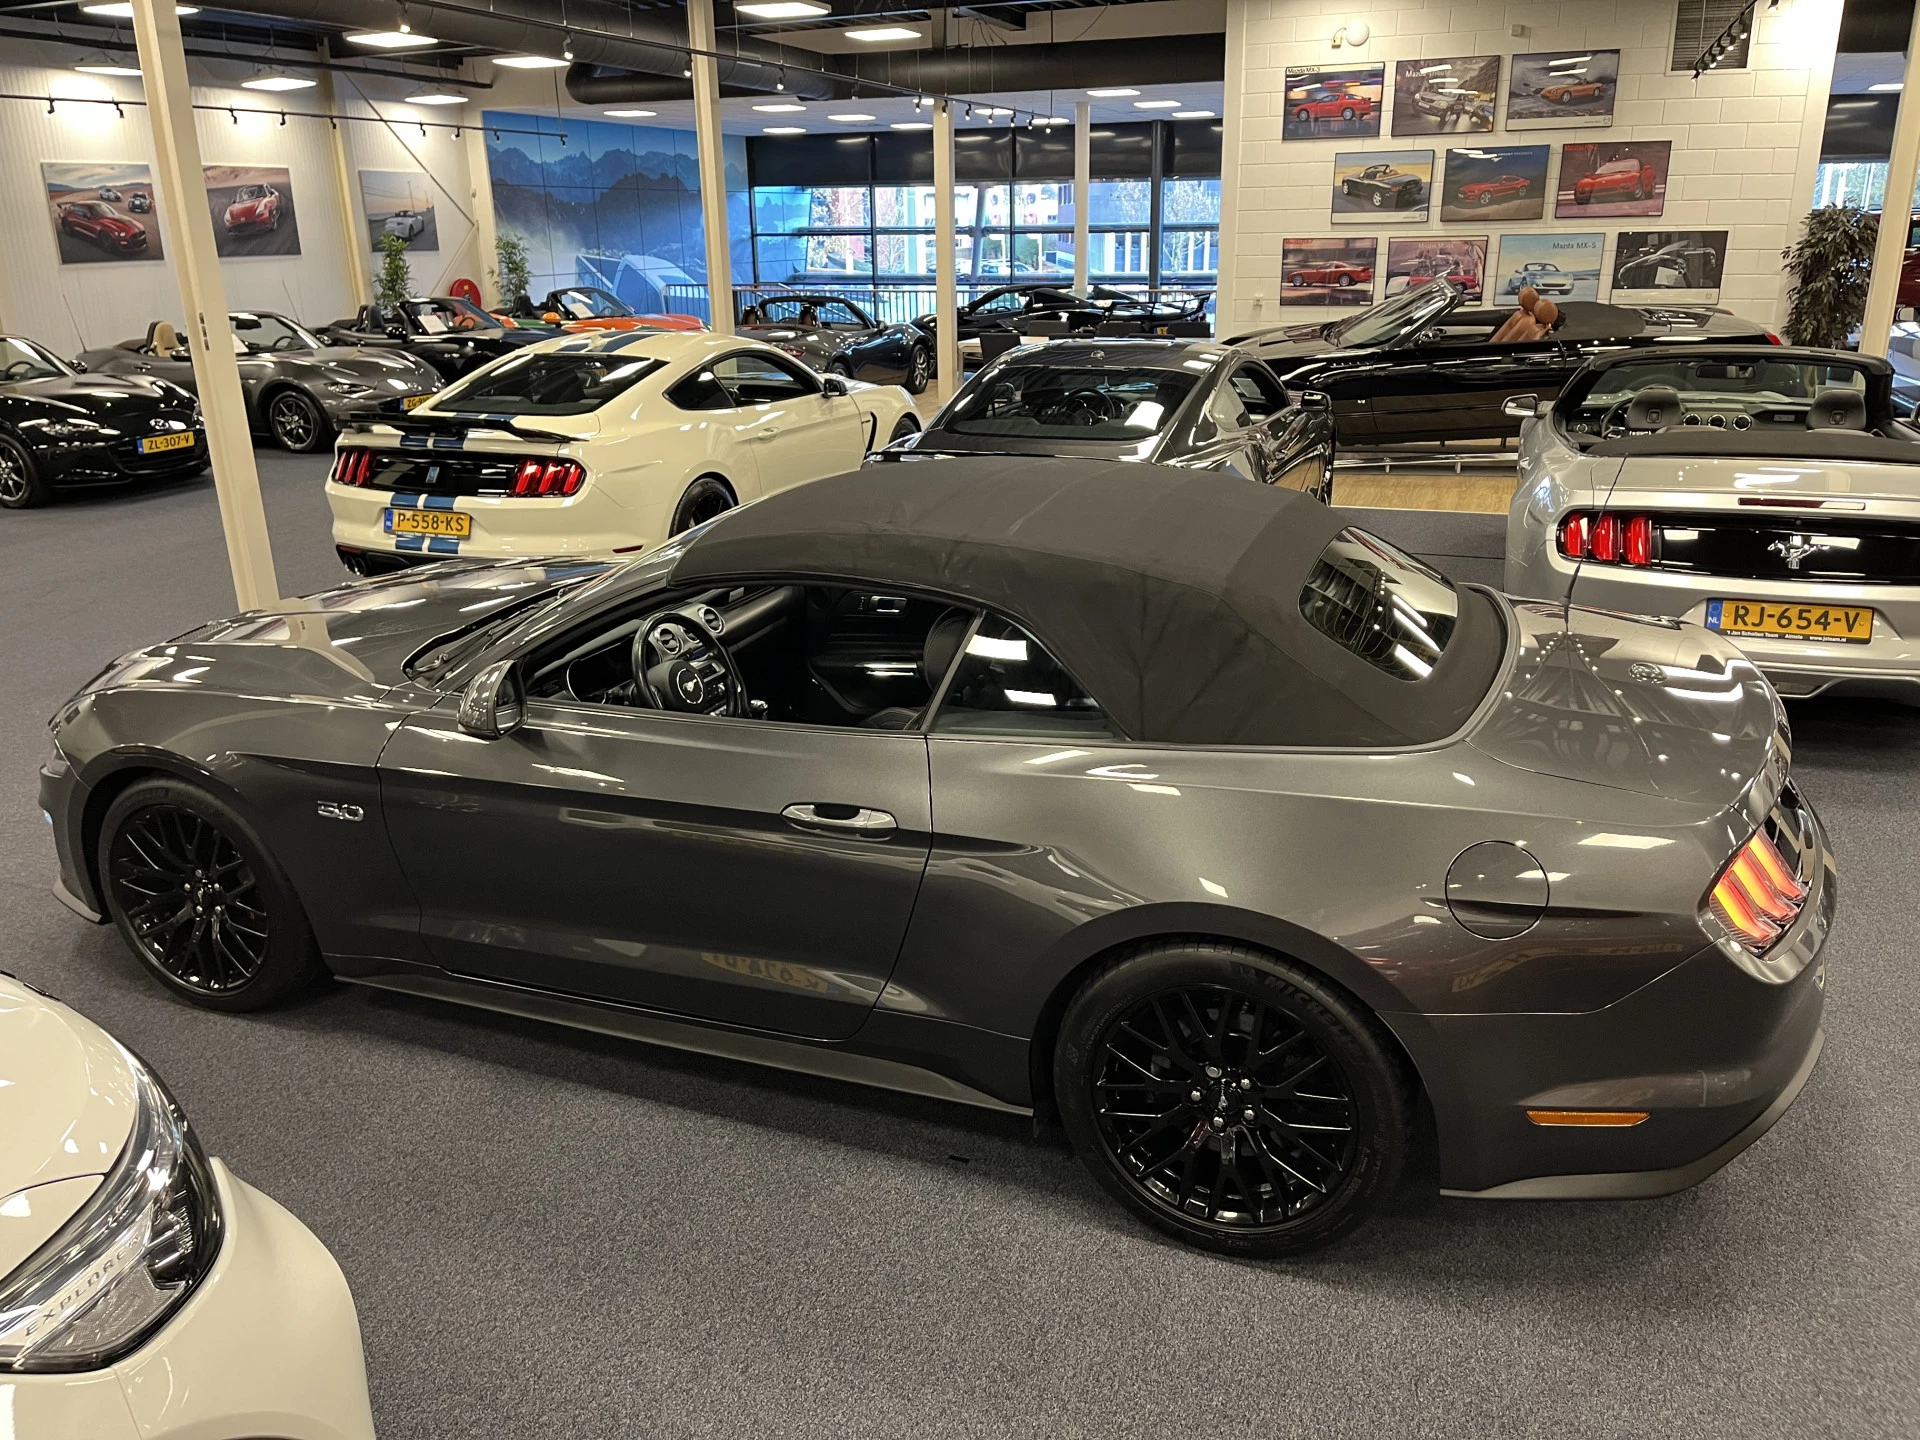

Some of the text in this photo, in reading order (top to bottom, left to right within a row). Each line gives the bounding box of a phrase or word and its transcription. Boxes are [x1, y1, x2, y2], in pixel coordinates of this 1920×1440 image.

[1576, 241, 1597, 249] MX-5
[147, 434, 190, 451] ZL-307-V
[397, 512, 464, 532] P-558-KS
[1708, 616, 1720, 624] NL
[1733, 604, 1861, 633] RJ-654-V
[317, 800, 364, 822] 5.0
[25, 1234, 141, 1337] EXPLORER
